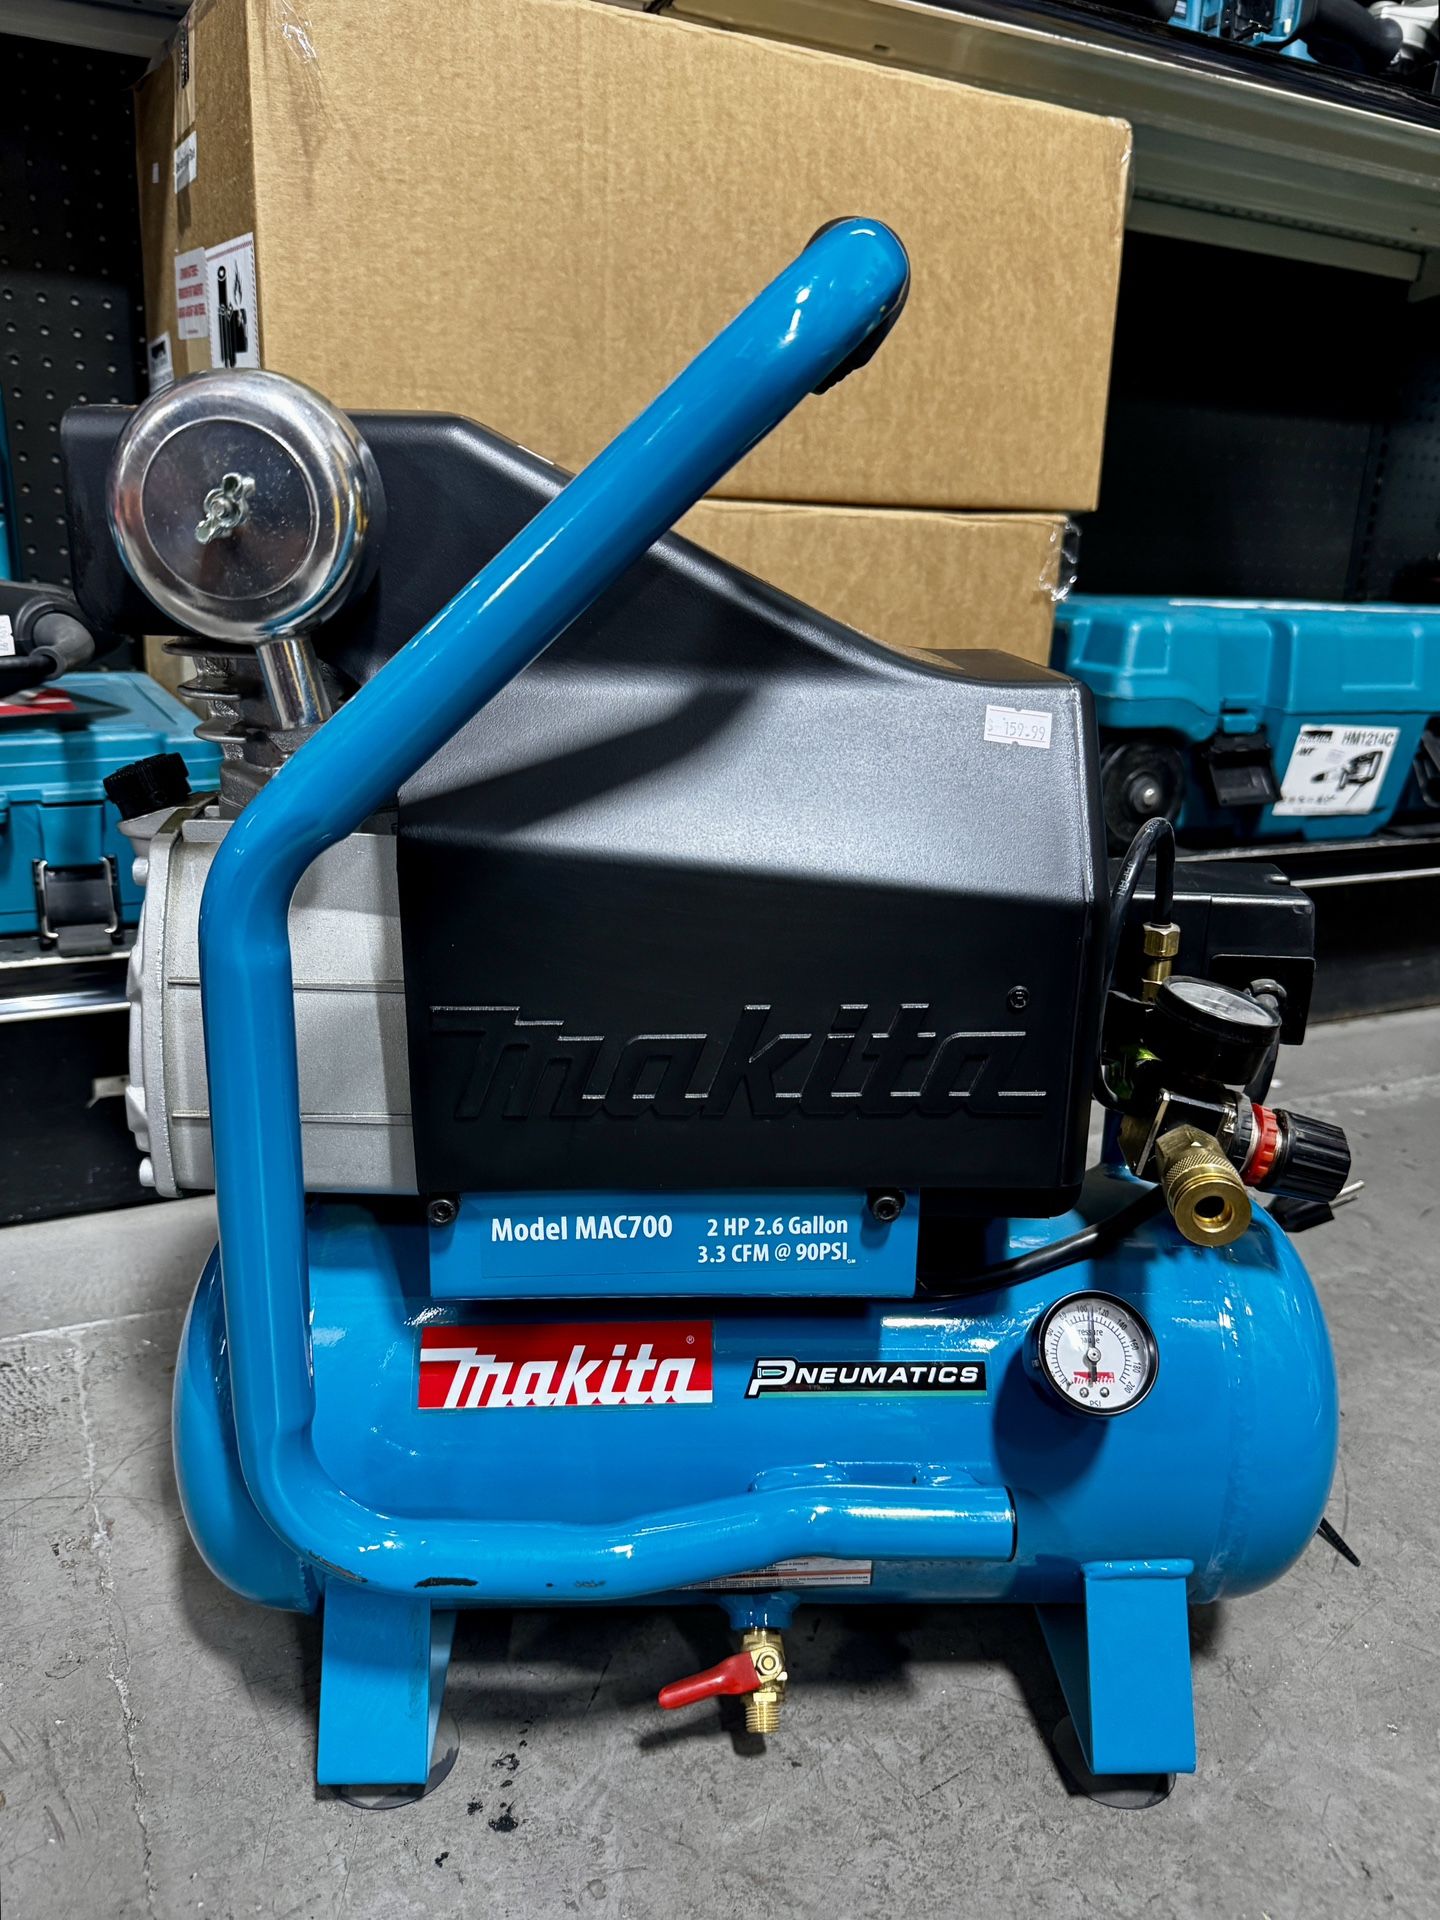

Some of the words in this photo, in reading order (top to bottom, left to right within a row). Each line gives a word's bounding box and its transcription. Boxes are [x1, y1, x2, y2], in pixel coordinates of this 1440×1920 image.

[1342, 730, 1394, 746] HM1214C
[429, 1003, 1047, 1118] makita
[491, 1216, 568, 1242] Model
[575, 1214, 673, 1240] MAC700
[707, 1218, 718, 1237] 2
[723, 1218, 750, 1236] HP
[755, 1217, 784, 1236] 2.6
[788, 1215, 849, 1235] Gallon
[697, 1245, 726, 1264] 3.3
[731, 1244, 770, 1263] CFM
[774, 1243, 791, 1261] @
[795, 1241, 848, 1261] 90PSI
[420, 1343, 713, 1409] makita
[748, 1359, 979, 1396] PNEUMATICS
